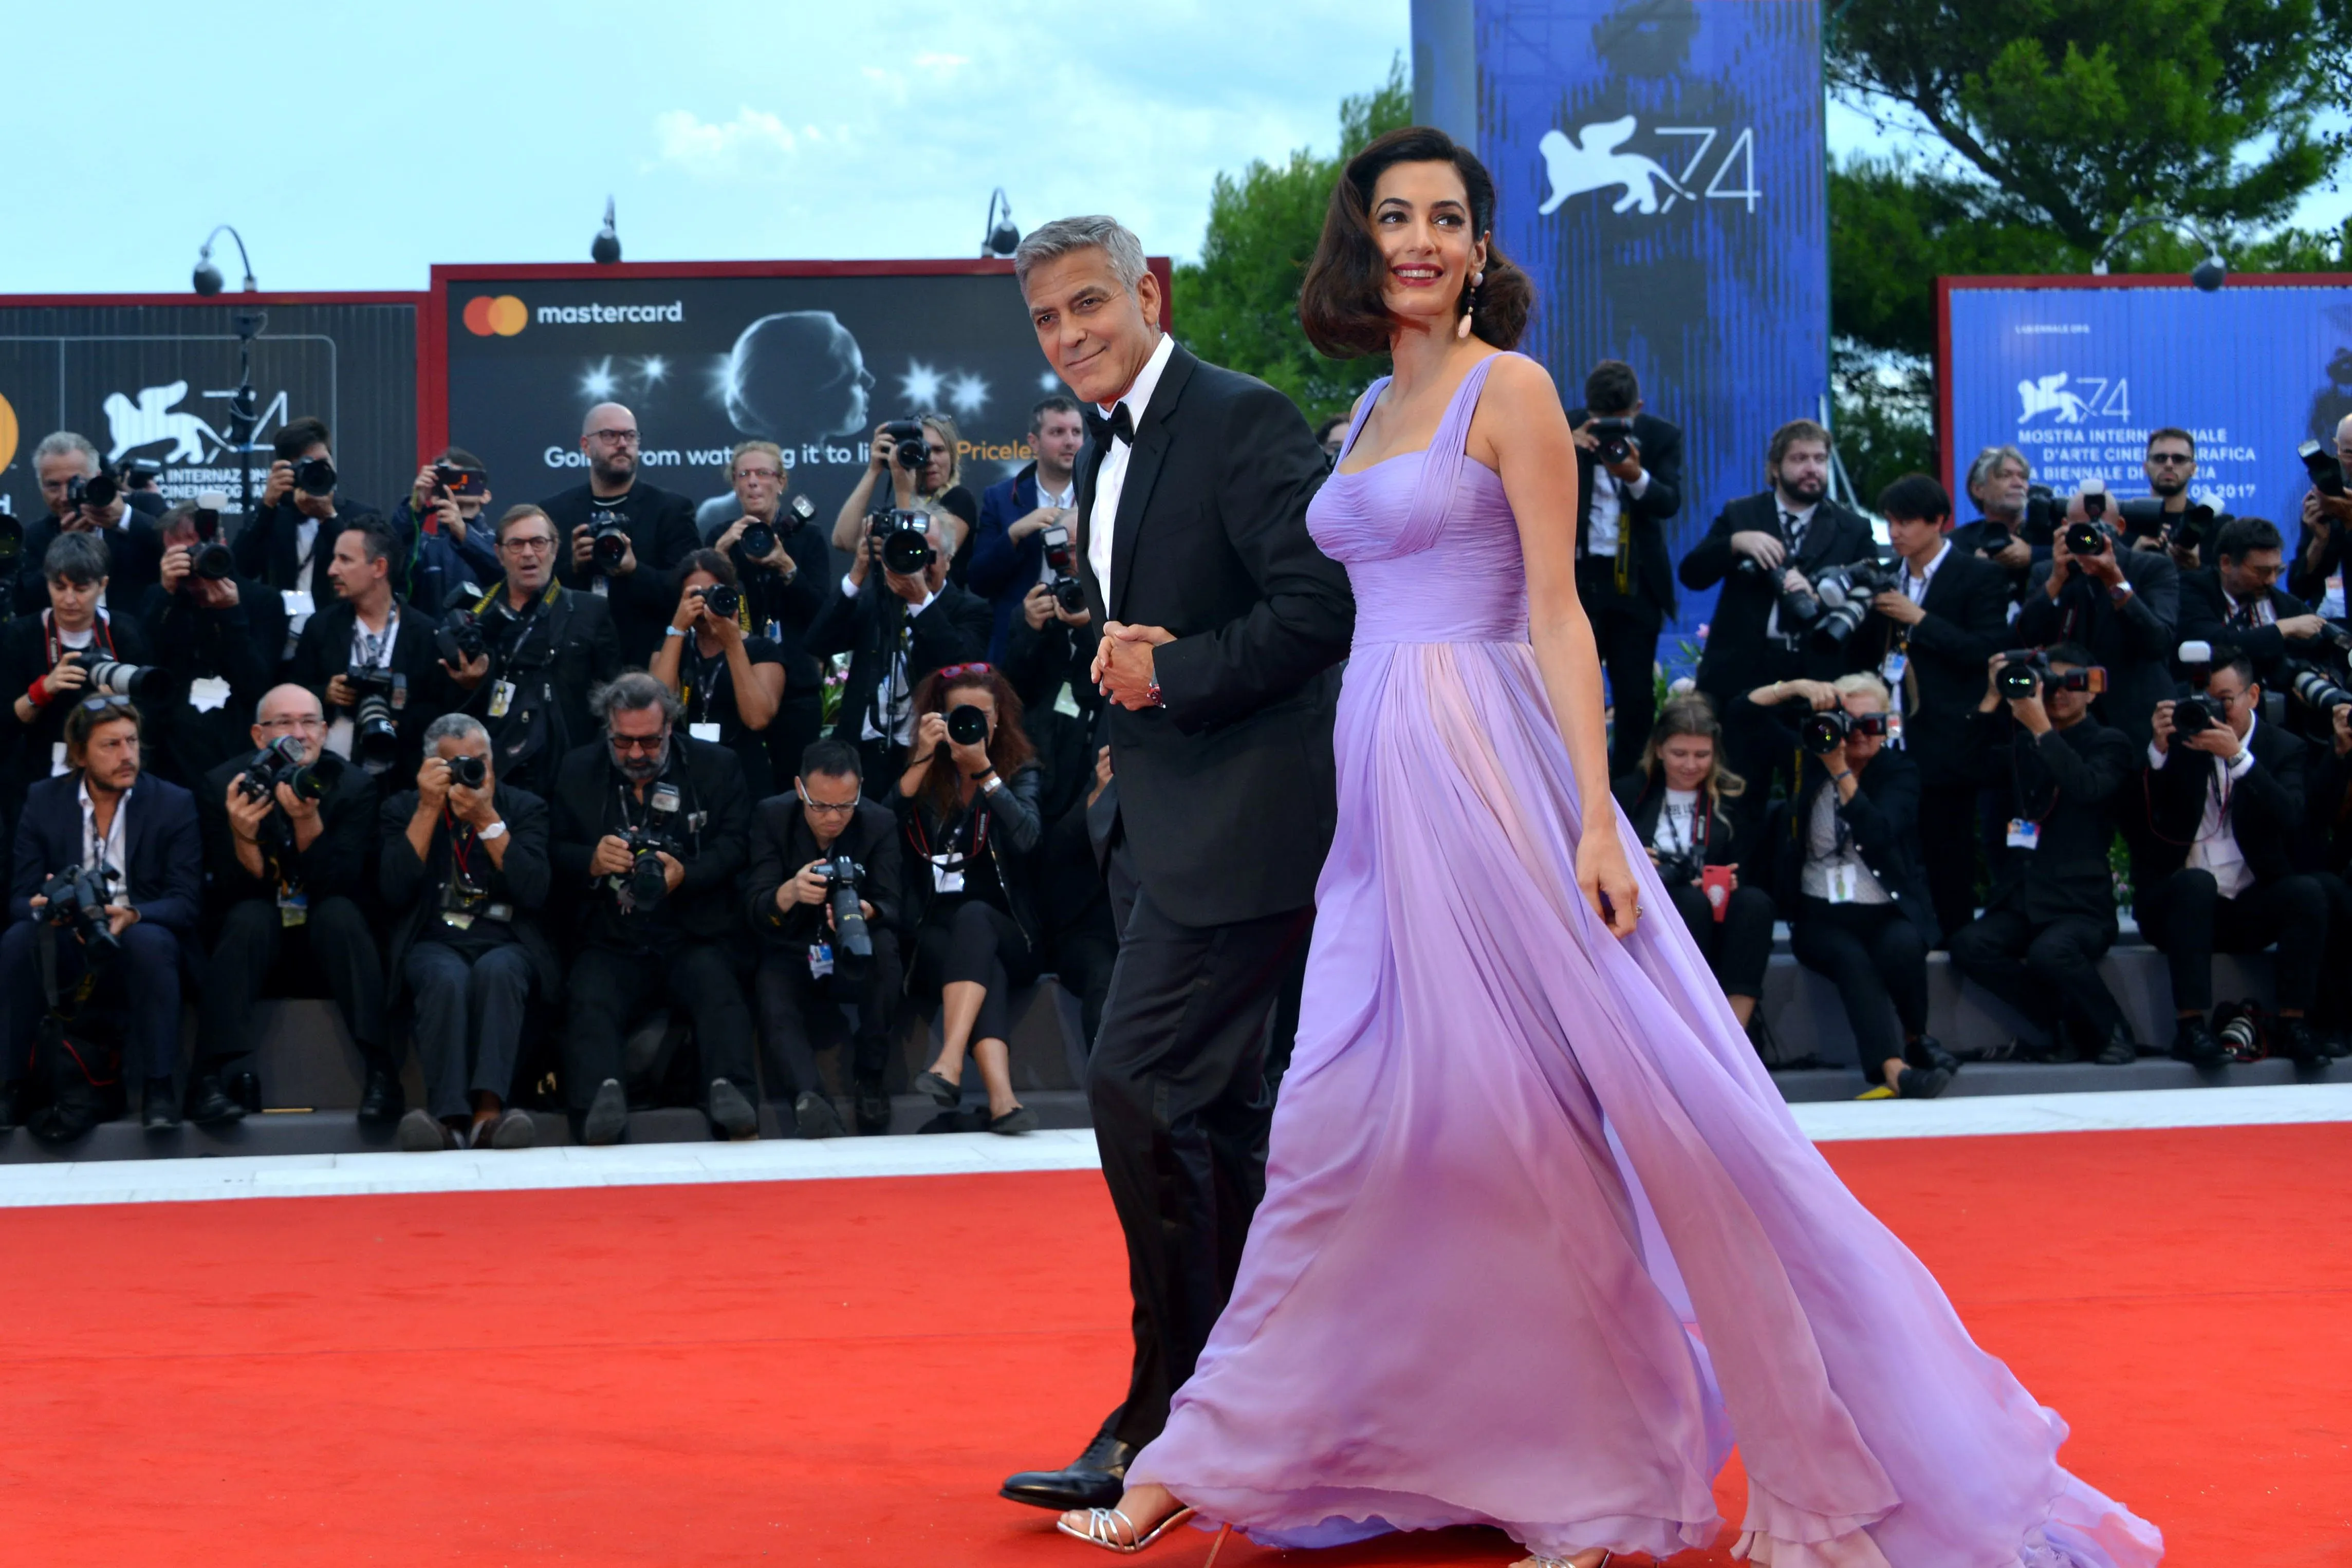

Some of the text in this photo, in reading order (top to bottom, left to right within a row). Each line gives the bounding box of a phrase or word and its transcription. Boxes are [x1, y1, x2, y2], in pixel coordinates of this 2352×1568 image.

[1654, 127, 1762, 214] 74
[538, 300, 682, 323] mastercard
[2075, 377, 2132, 423] 74
[2017, 428, 2227, 444] MOSTRA INTERNNALE
[543, 445, 591, 468] Goi
[802, 443, 820, 463] it
[825, 444, 851, 463] to
[2043, 445, 2256, 462] D'ARTE CINERAFICA
[2043, 465, 2123, 480] BIENNALE
[2127, 466, 2144, 480] DI
